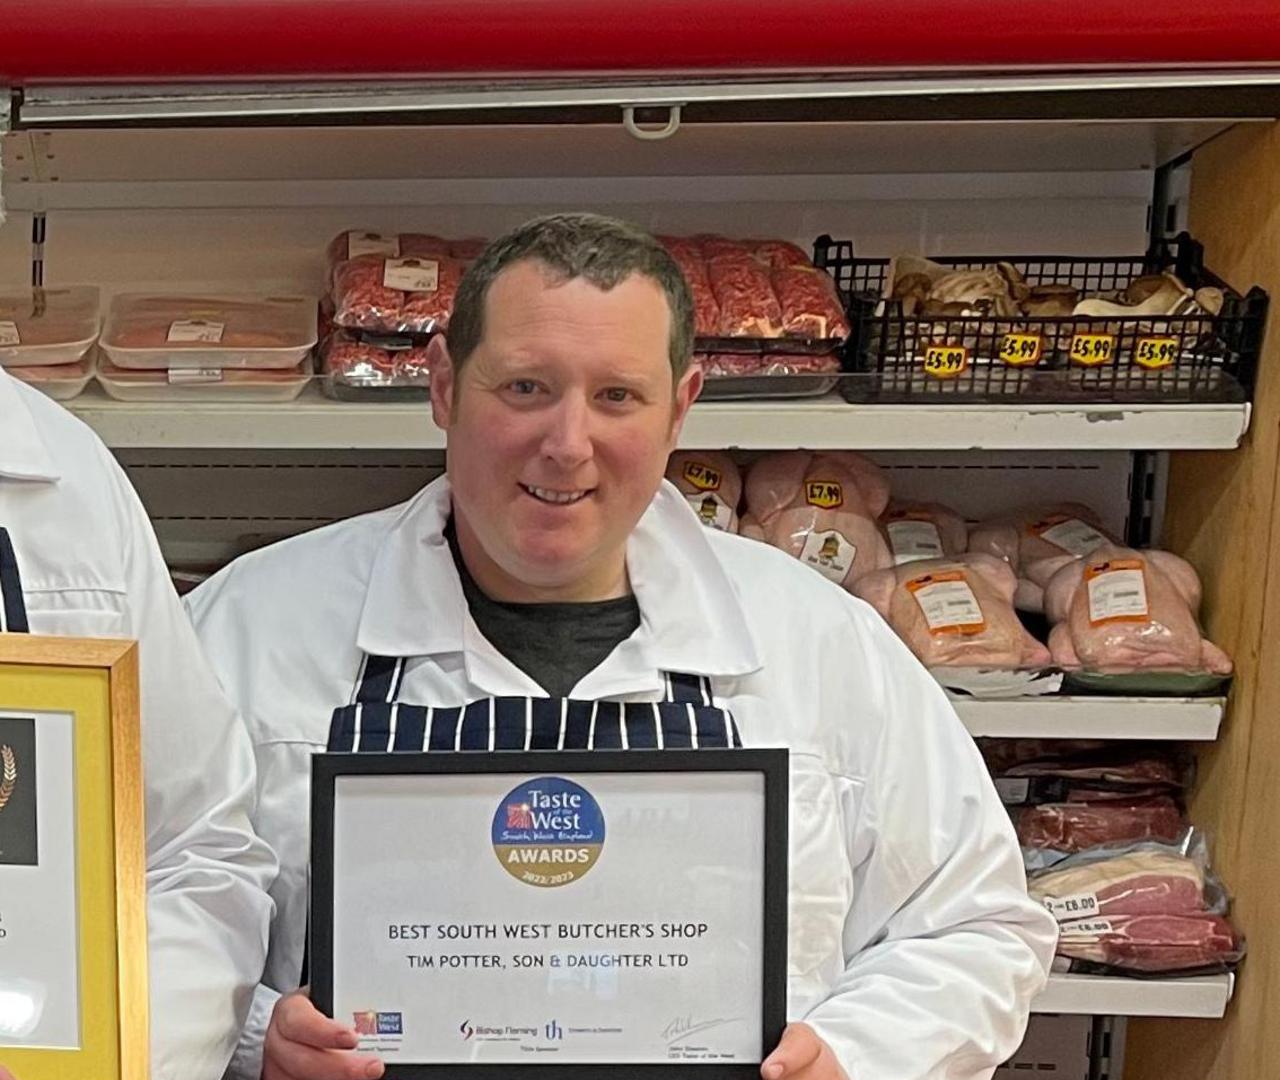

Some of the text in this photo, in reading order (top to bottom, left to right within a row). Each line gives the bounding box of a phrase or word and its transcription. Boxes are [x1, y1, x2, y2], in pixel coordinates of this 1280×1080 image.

[1003, 337, 1037, 356] £5.99
[1073, 338, 1109, 357] £5.99
[1138, 341, 1175, 360] £5.99
[927, 350, 963, 369] £5.99
[809, 484, 840, 501] £7.99
[528, 790, 581, 808] Taste
[530, 812, 581, 830] West
[508, 848, 590, 863] AWARDS
[389, 923, 708, 939] BEST SOUTH WEST BUTCHER'S SHOP
[407, 955, 689, 970] TIM POTTER, SON & DAUGHTER LTD
